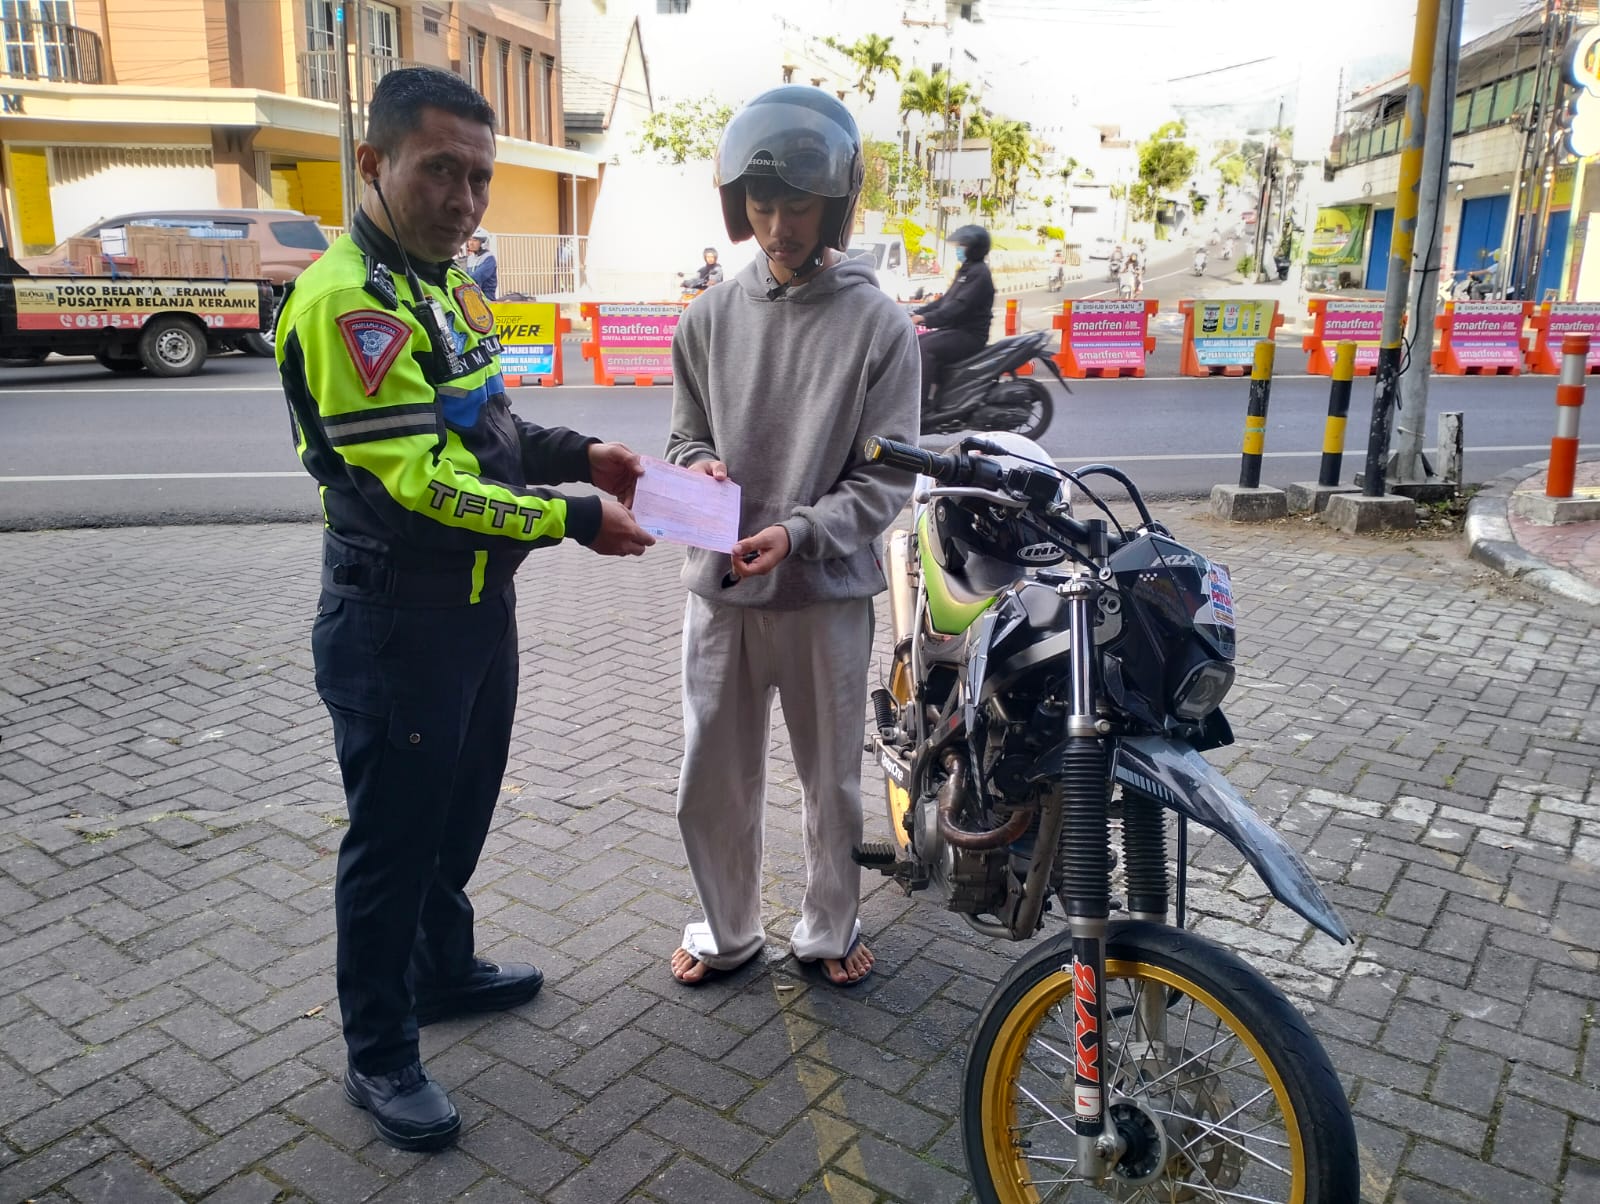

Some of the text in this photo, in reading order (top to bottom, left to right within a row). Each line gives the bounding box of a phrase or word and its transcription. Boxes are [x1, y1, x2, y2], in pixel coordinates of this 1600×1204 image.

[748, 158, 787, 167] HONDA
[56, 286, 226, 297] TOKO BELANA ERAMIK
[58, 297, 131, 307] PUSATNYA
[136, 297, 194, 308] BELANJA
[199, 298, 256, 308] KERAMIK
[602, 323, 659, 334] smartfren
[1073, 320, 1122, 330] smartfren
[1326, 318, 1374, 329] smartfren
[1454, 320, 1500, 330] smartfren
[1551, 321, 1594, 330] smartfren
[1079, 350, 1123, 359] smartfren
[1459, 350, 1500, 358] smartfren
[608, 355, 660, 365] smartfren
[428, 479, 543, 534] TFTT
[1025, 546, 1062, 557] INK
[1150, 555, 1198, 567] KLX
[1074, 961, 1100, 1083] KYB
